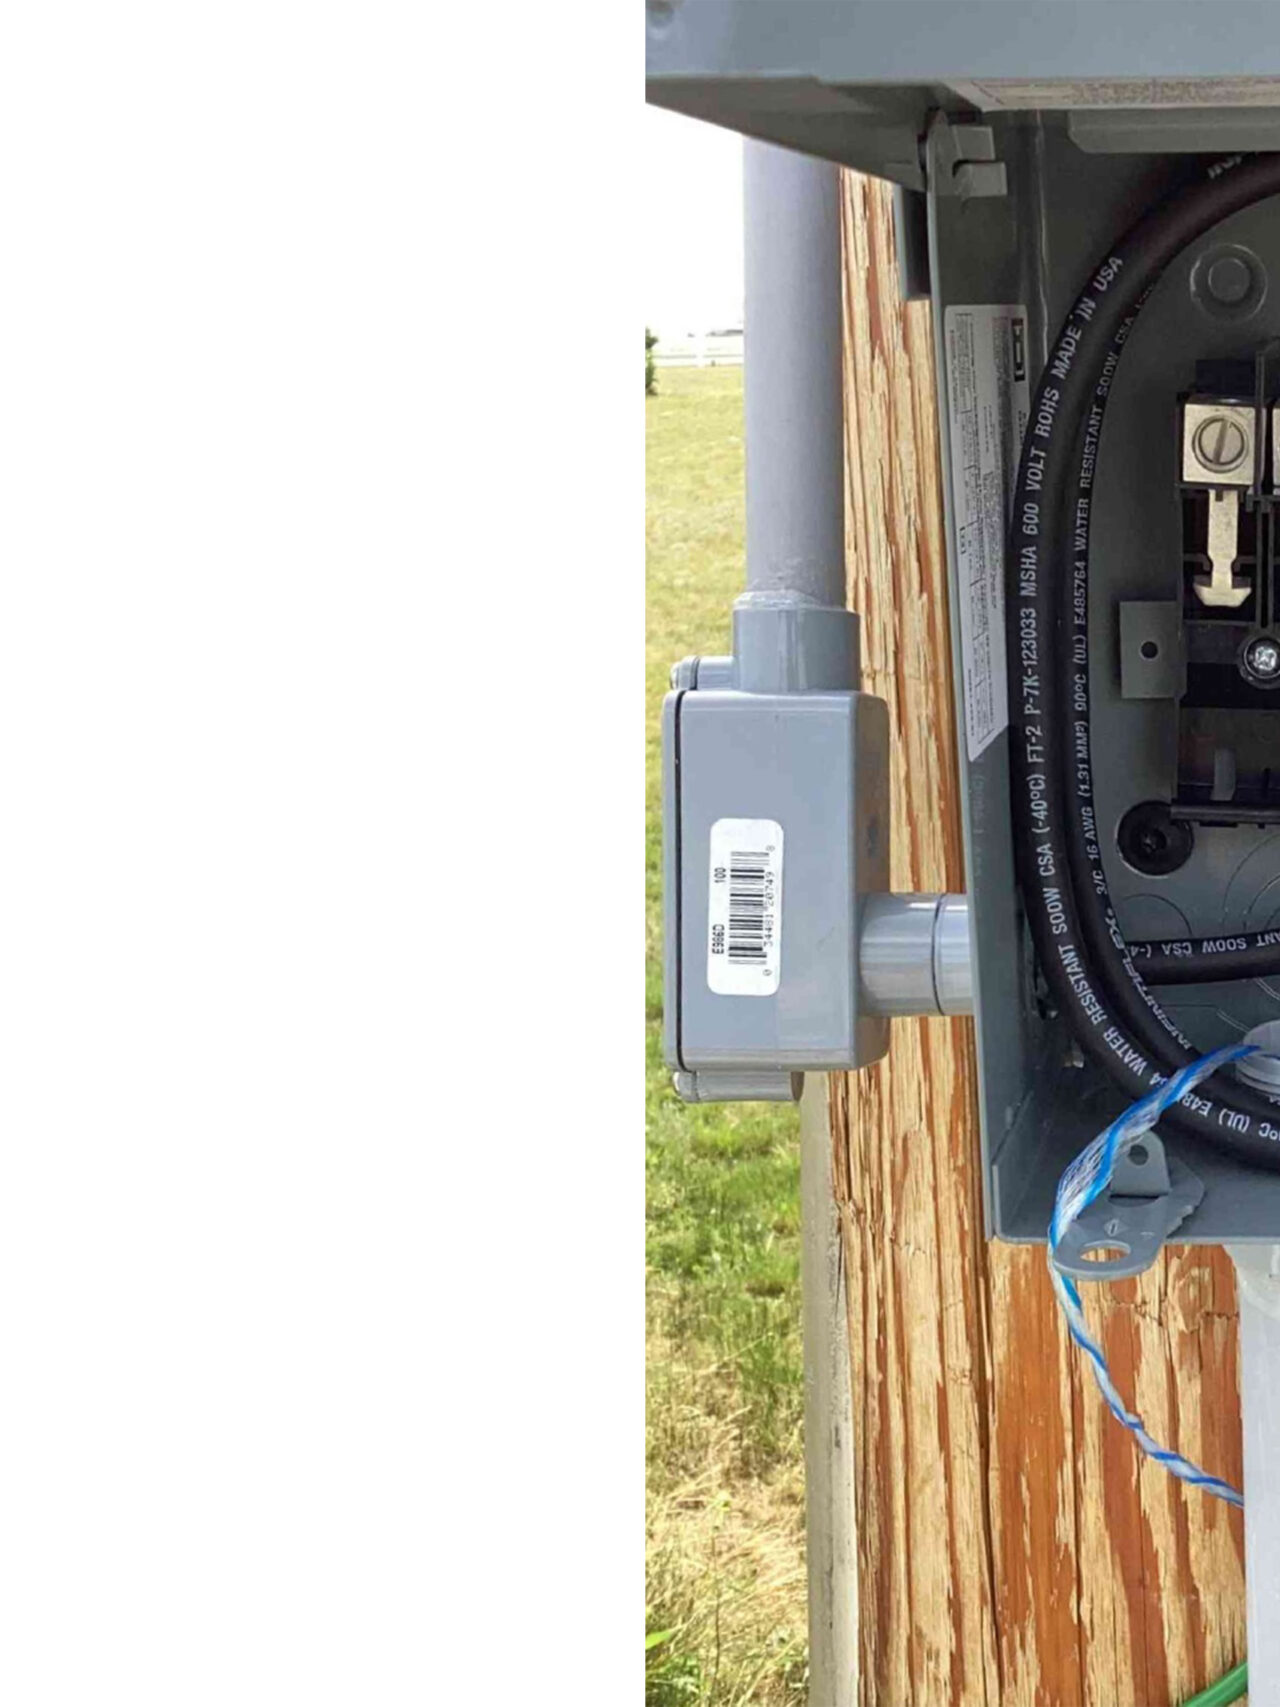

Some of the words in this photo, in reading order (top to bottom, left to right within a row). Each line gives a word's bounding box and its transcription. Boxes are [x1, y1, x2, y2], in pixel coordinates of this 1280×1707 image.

[1093, 256, 1124, 292] USA
[1076, 297, 1097, 321] IN
[1114, 316, 1135, 345] CSA
[1051, 327, 1083, 380] MADE
[1097, 351, 1120, 397] SOOW
[1035, 386, 1060, 438] ROHS
[1079, 404, 1103, 488] RESISTANT
[1025, 446, 1048, 491] VOLT
[1022, 503, 1039, 535] 600
[1074, 498, 1090, 551] WATER
[1019, 546, 1038, 597] MSHA
[1074, 561, 1087, 626] E485764
[1020, 608, 1042, 715] P-7K-123033
[1072, 635, 1088, 664] (UL)
[1025, 725, 1046, 764] FT-2
[1081, 806, 1098, 841] AWG
[1036, 843, 1057, 877] CSA
[1086, 845, 1101, 860] 16
[714, 867, 726, 883] 100
[764, 871, 774, 906] 20749
[1092, 870, 1108, 896] 3/C
[1043, 887, 1068, 936] SOOW
[763, 914, 774, 947] 34481
[1202, 936, 1248, 955] SOOW
[1162, 941, 1193, 957] CSA
[1058, 944, 1108, 1026] RESISTANT
[1103, 1025, 1149, 1077] WATER
[1218, 1109, 1251, 1133] (UL)
